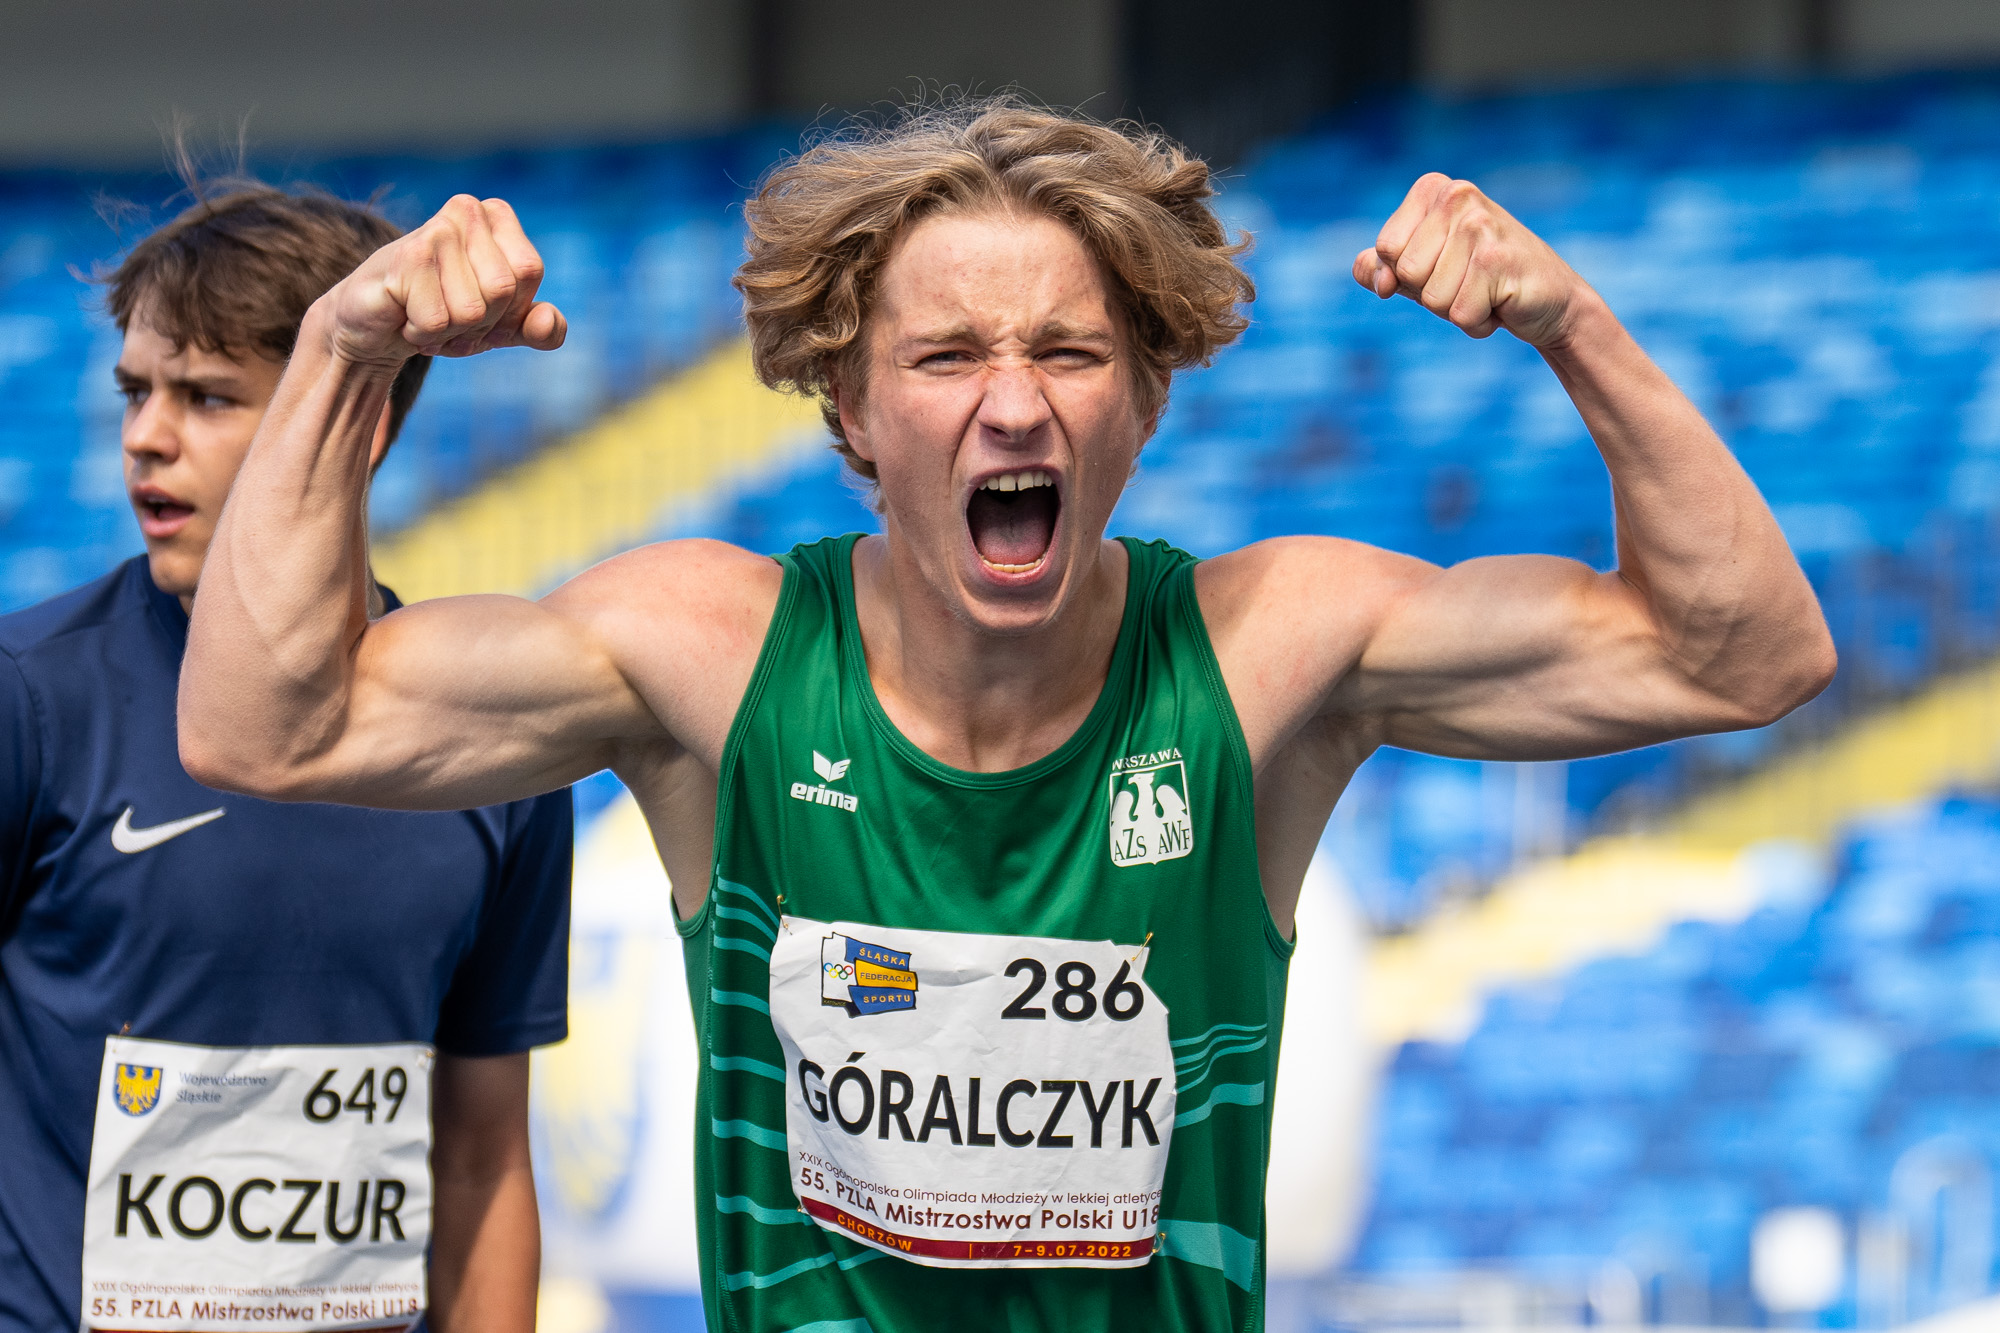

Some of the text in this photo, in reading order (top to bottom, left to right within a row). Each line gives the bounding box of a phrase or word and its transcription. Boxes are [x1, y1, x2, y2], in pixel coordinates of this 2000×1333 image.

[790, 782, 858, 813] erima
[1114, 820, 1190, 861] AZS AWF
[859, 947, 906, 967] ŚLĄSKA
[860, 972, 912, 983] FEDERACJA
[863, 994, 911, 1004] SPORTU
[1001, 958, 1144, 1021] 286
[302, 1066, 408, 1124] 649
[798, 1052, 1162, 1149] GÓRALCZYK
[799, 1152, 1162, 1206] XXIX Ogólnopolska Olimpiada Młodzieży w lekkiej atletyce
[800, 1167, 1160, 1230] 55. PZLA Mistrzostwa Polski U18
[114, 1173, 407, 1244] KOCZUR
[837, 1213, 1132, 1257] CHORZÓW 7-9.07.2022
[91, 1298, 418, 1321] 55. PZLA Mistrzostwa Polski U18
[92, 1281, 116, 1292] XXIX
[120, 1281, 205, 1296] Ogólnopolska
[208, 1284, 272, 1298] Olimpiada
[275, 1284, 325, 1297] Młodzieży
[328, 1286, 338, 1294] w
[340, 1283, 371, 1295] lekkiej
